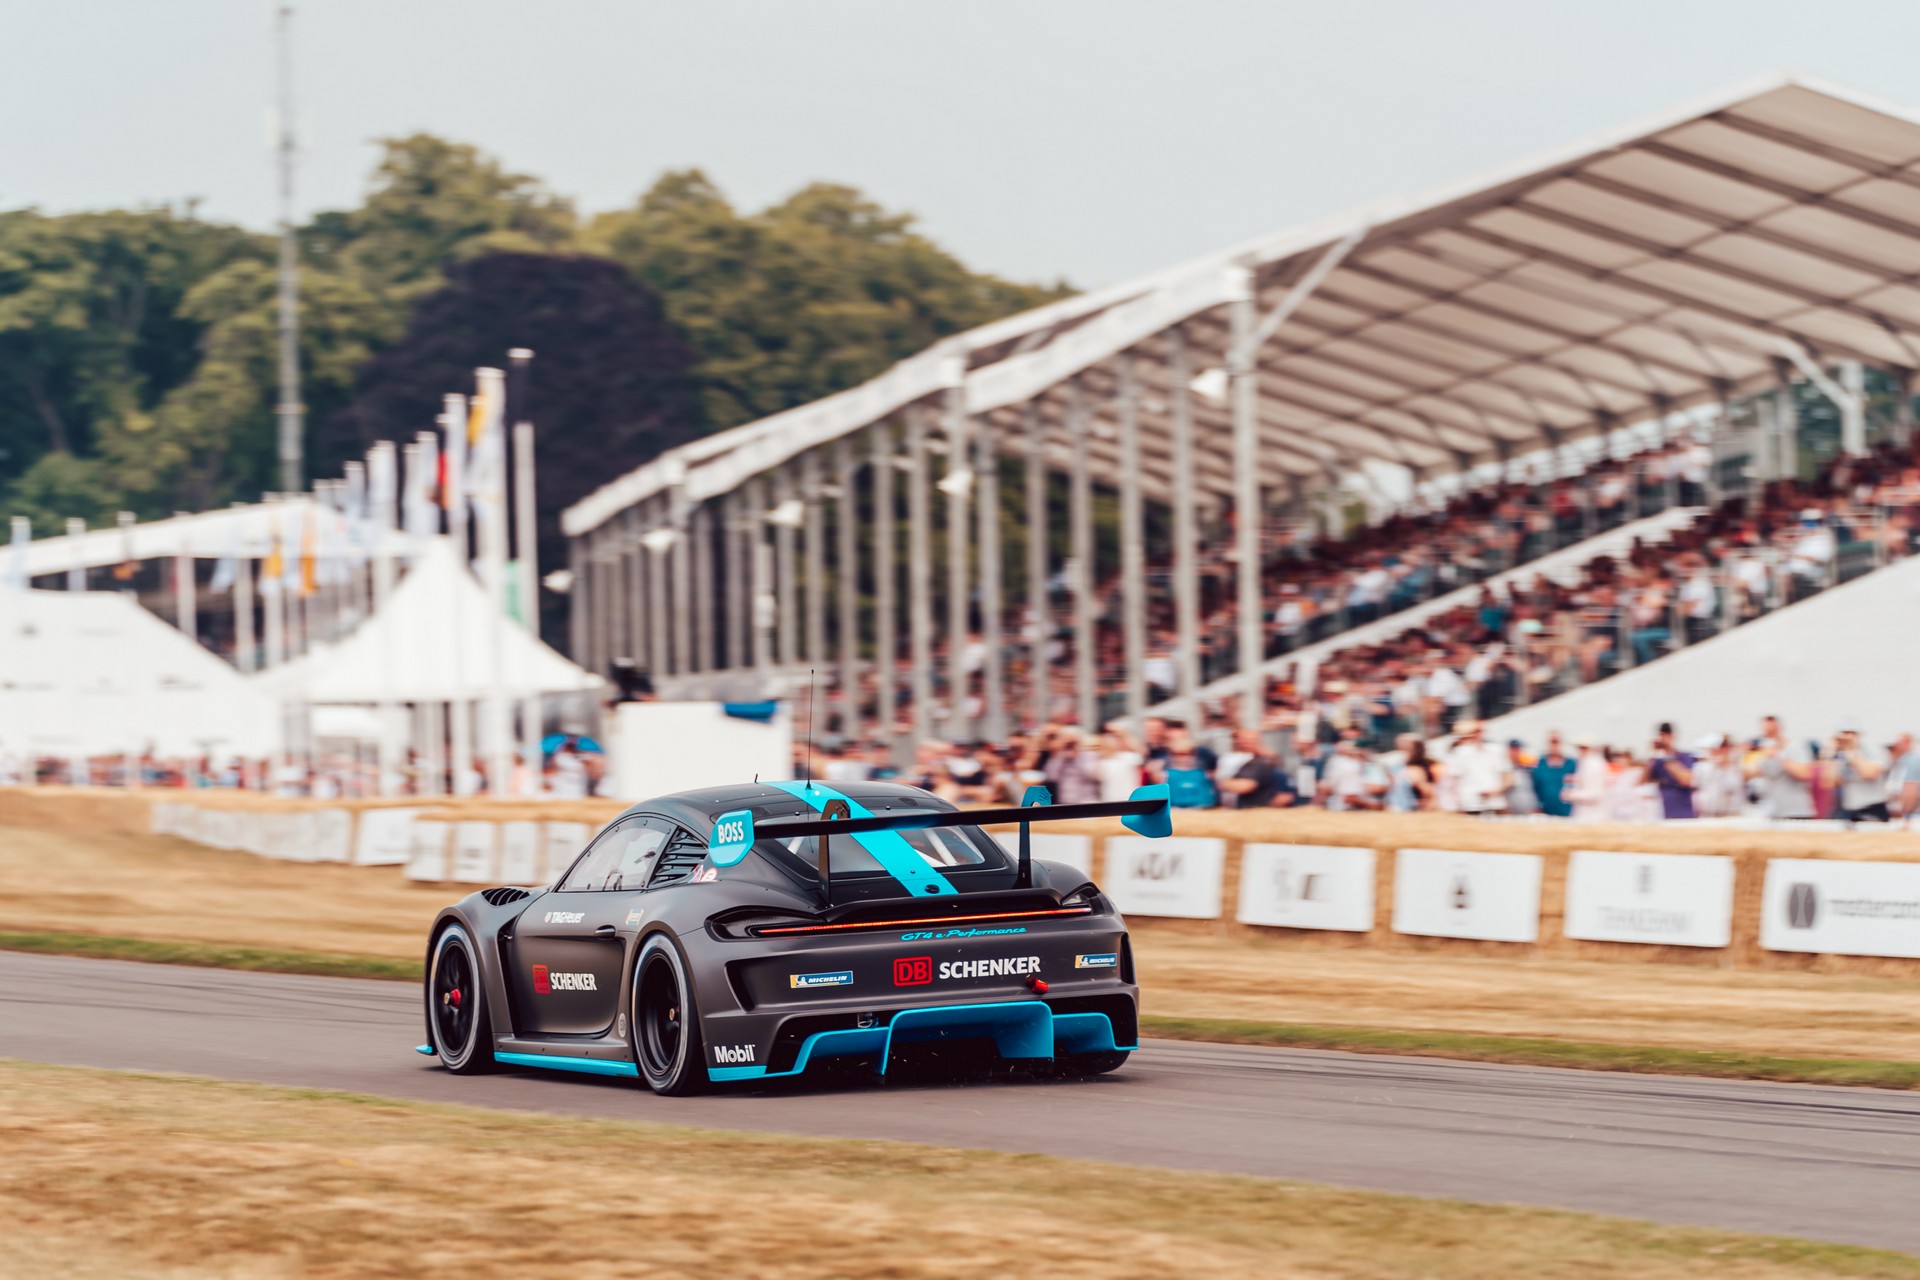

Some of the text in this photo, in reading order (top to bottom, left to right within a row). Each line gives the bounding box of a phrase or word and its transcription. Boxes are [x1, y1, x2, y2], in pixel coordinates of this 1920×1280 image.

[717, 820, 745, 844] BOSS
[900, 926, 1028, 941] GT4 e-Performance
[898, 956, 1042, 983] DB SCHENKER
[549, 972, 598, 991] SCHENKER
[808, 975, 848, 984] MICHELIN
[713, 1044, 756, 1064] Mobil
